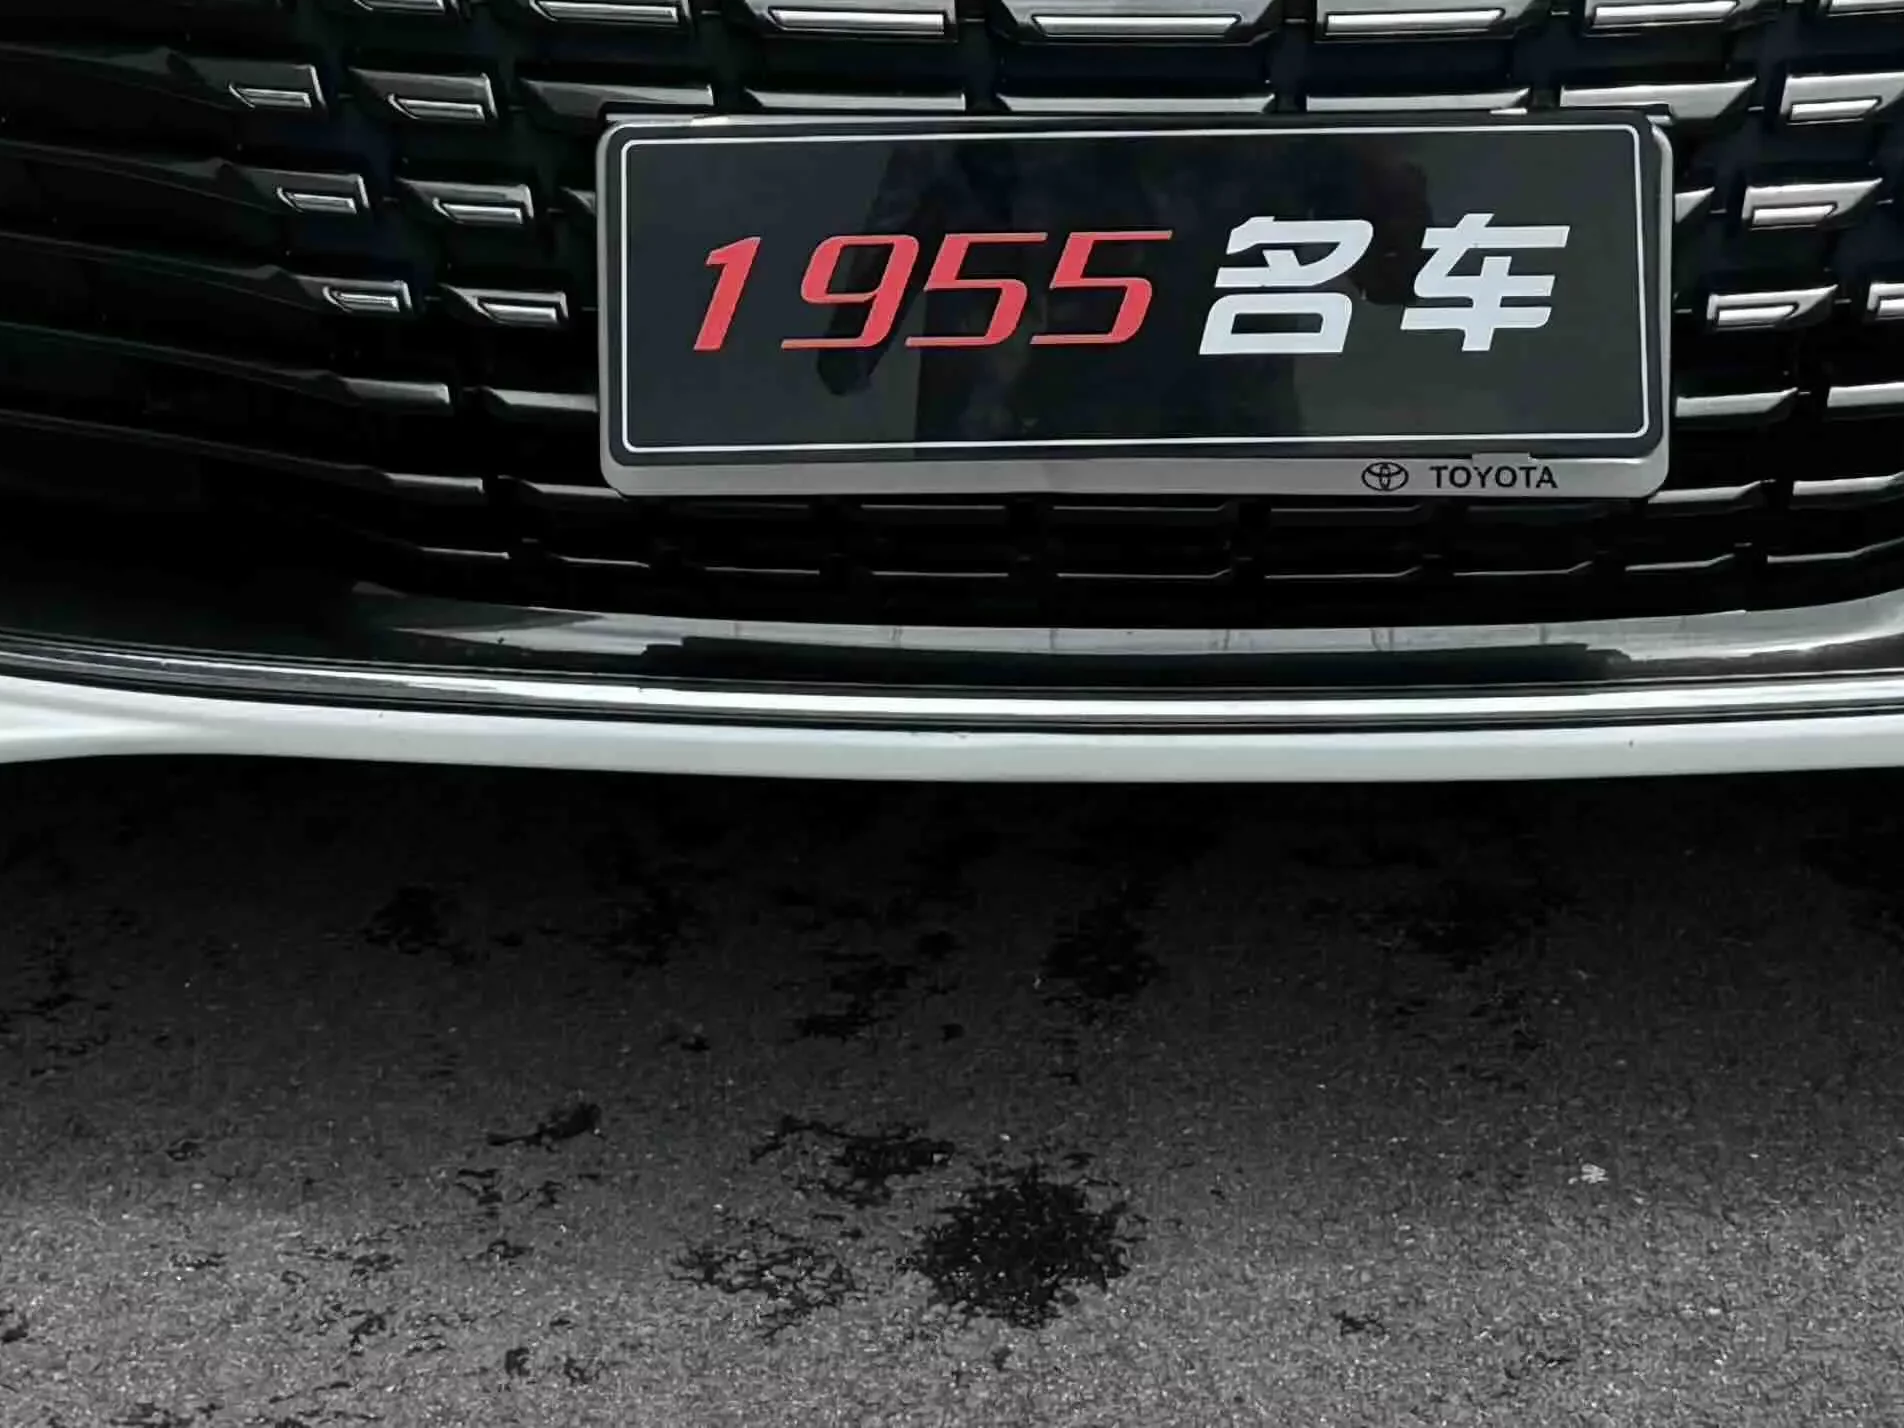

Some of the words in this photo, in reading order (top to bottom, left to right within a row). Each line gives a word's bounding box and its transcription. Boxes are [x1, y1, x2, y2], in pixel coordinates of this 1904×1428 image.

[693, 230, 1173, 351] 1955
[1198, 213, 1571, 355] 名车
[1429, 465, 1559, 489] TOYOTA
